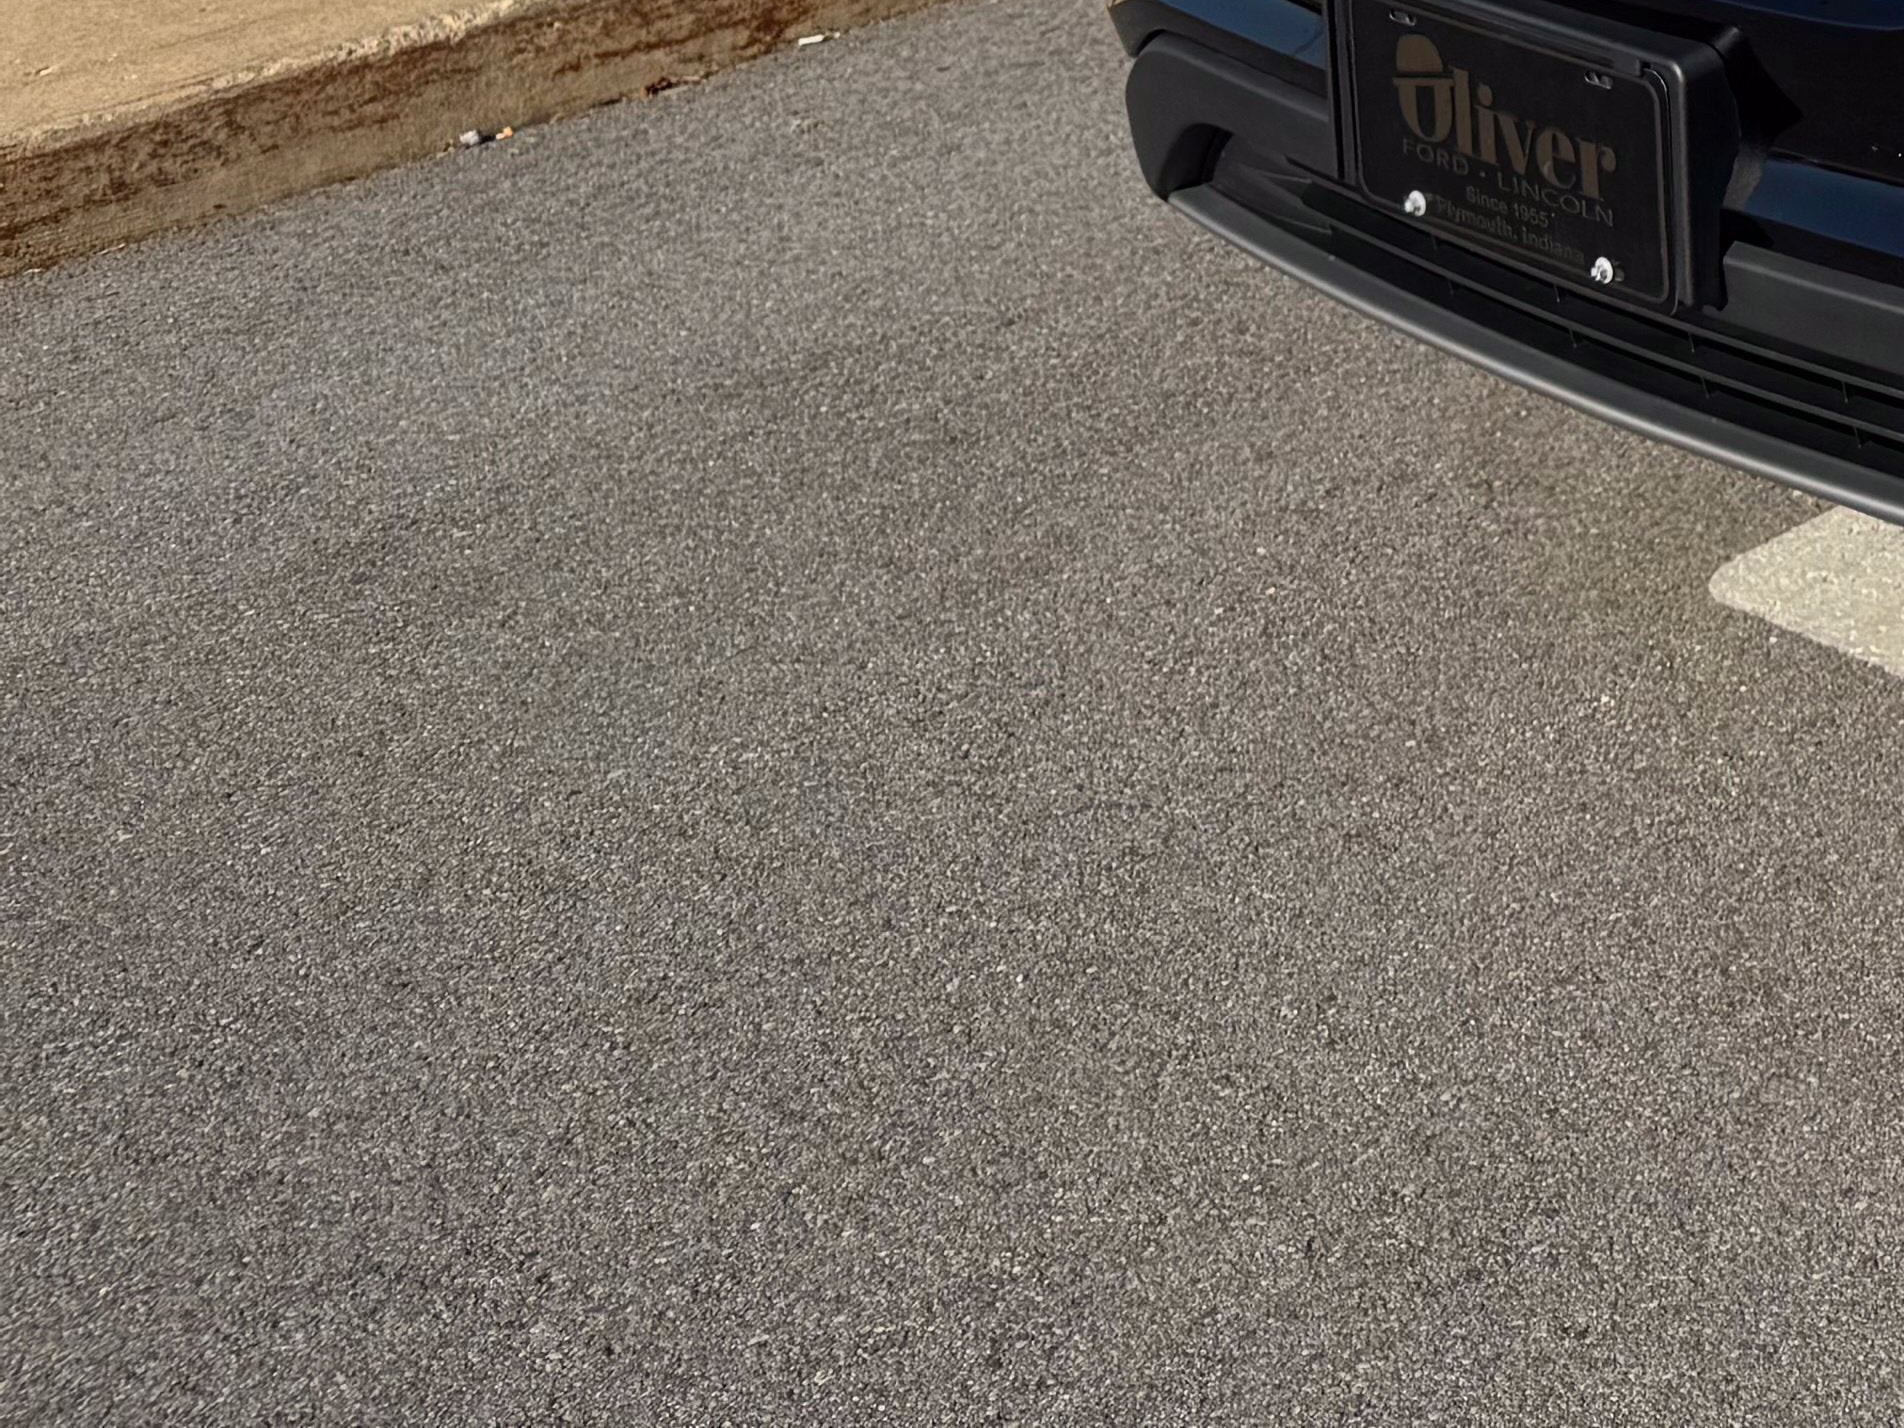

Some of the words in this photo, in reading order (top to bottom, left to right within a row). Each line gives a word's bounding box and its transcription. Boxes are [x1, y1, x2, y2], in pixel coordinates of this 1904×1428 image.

[1392, 34, 1617, 201] Oliver
[1402, 137, 1470, 176] FORD
[1497, 170, 1615, 228] LINCOLN
[1465, 185, 1510, 216] Since
[1512, 202, 1550, 229] 1955
